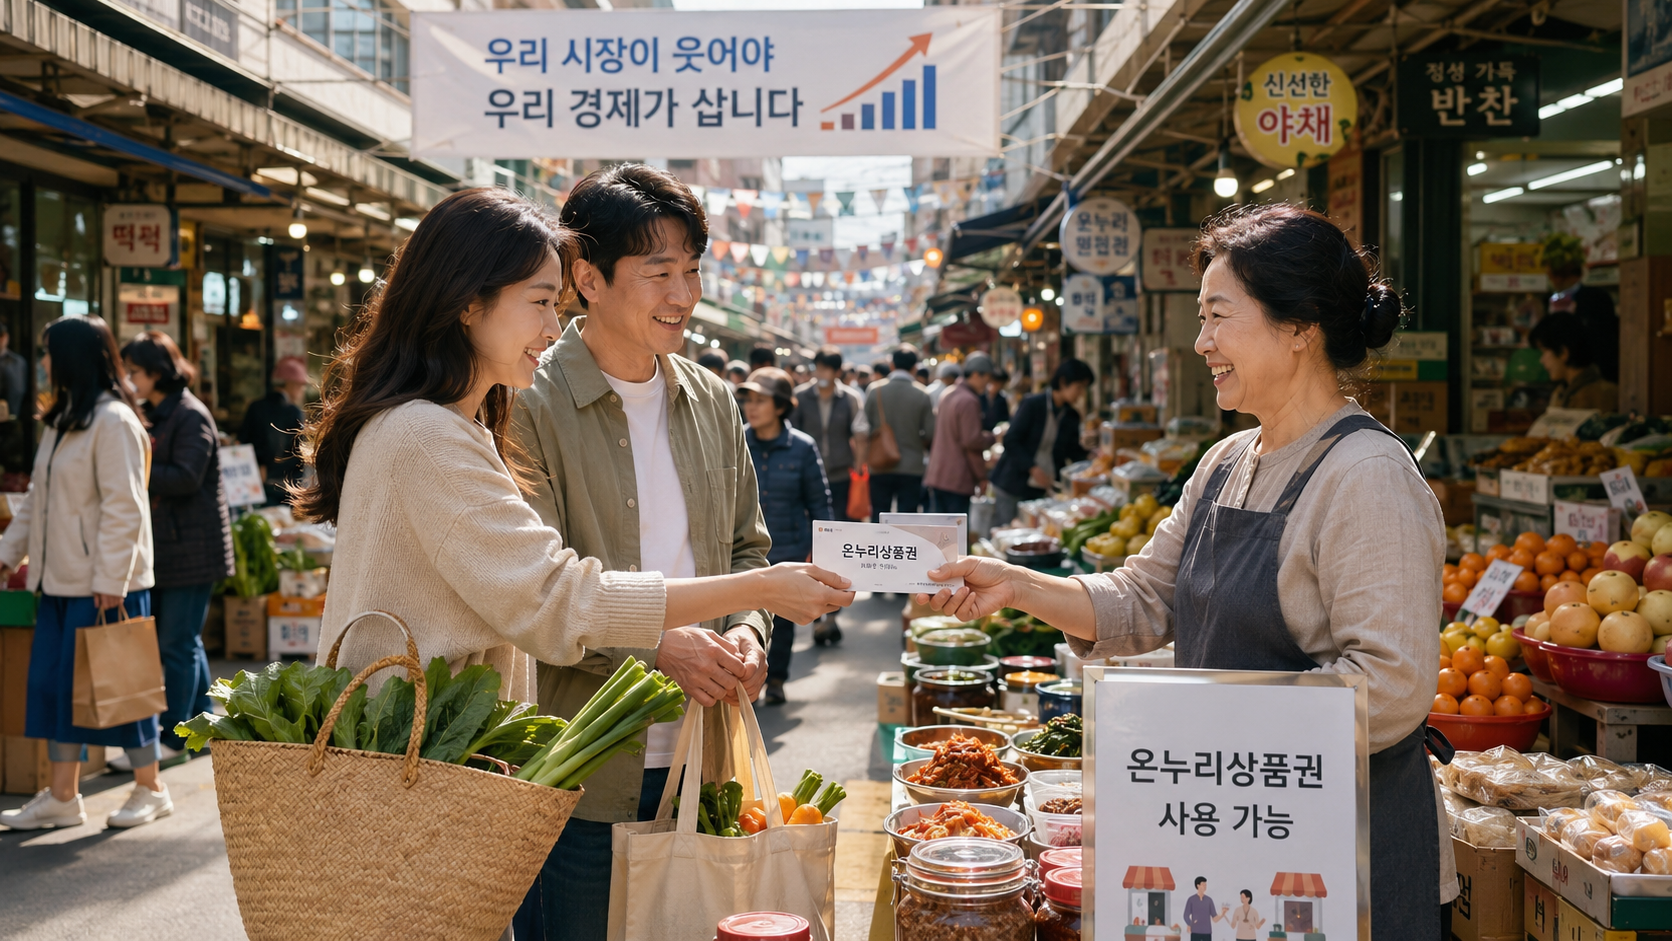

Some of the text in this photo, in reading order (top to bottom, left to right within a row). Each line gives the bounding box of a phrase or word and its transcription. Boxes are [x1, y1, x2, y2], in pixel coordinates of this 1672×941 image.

[484, 36, 775, 74] 우리 시장이 웃어야
[1425, 61, 1517, 83] 정성 가득
[1263, 72, 1332, 98] 신선한
[484, 87, 804, 129] 우리 경제가 삽니다
[1258, 104, 1332, 145] 야채
[1430, 85, 1519, 127] 반찬
[1126, 748, 1323, 789] 온누리상품권
[1158, 801, 1294, 840] 사용 가능
